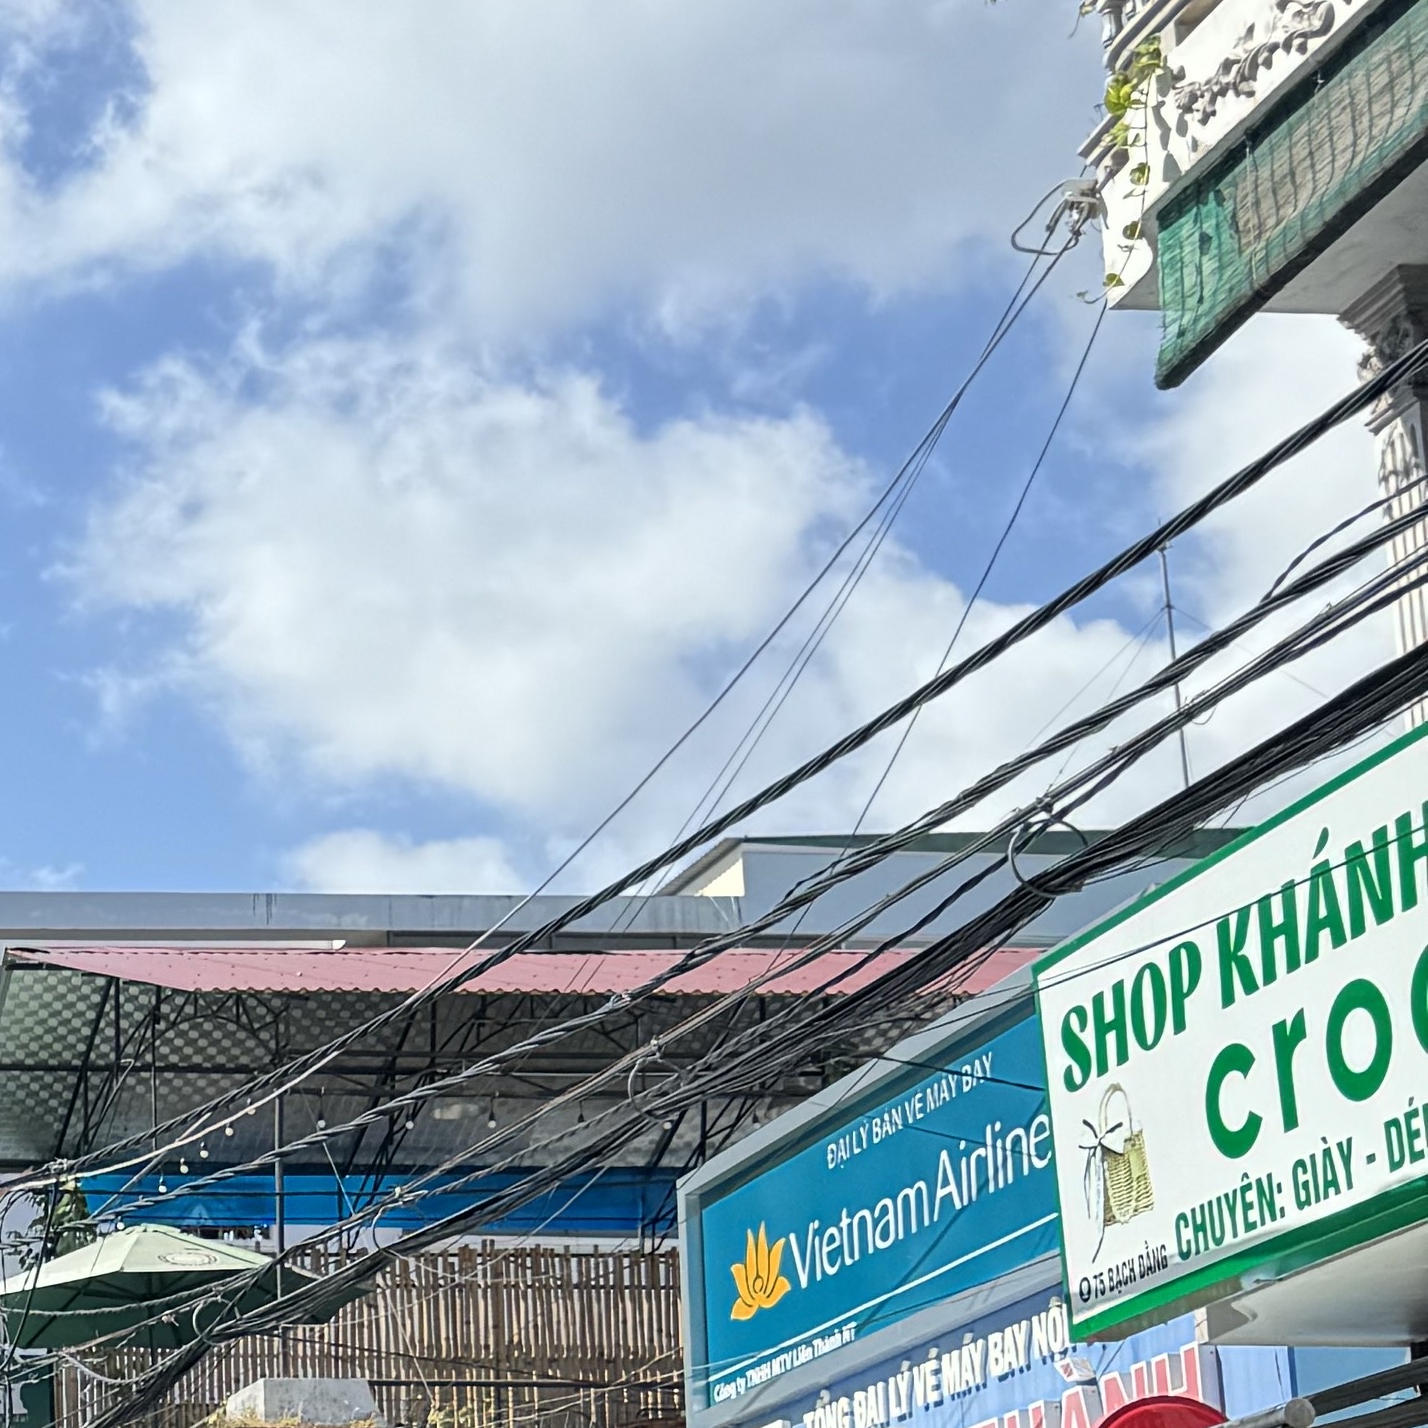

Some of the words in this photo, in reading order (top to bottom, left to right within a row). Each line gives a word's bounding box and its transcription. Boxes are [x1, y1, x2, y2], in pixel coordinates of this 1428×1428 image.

[1061, 939, 1202, 1093] SHOP
[827, 1141, 851, 1171] ĐẠI
[852, 1125, 870, 1156] LÝ
[872, 1109, 904, 1144] BÁN
[905, 1092, 925, 1126] VÉ
[926, 1076, 959, 1116] MÁY
[962, 1052, 993, 1093] BAY
[788, 1177, 930, 1290] Vietnam
[933, 1113, 1053, 1222] Airline
[1175, 1170, 1286, 1262] CHUYÊN:
[1292, 1136, 1355, 1214] GIÀY
[1384, 1096, 1428, 1174] DÉ
[1093, 1270, 1106, 1299] 75
[1107, 1256, 1137, 1298] BẠCH
[713, 1382, 737, 1403] Công
[746, 1361, 771, 1388] TNHH
[771, 1350, 792, 1377] MTV
[793, 1344, 813, 1367] Liên
[890, 1360, 913, 1420] LÝ
[913, 1347, 943, 1411] VÉ
[943, 1332, 988, 1399] MÁY
[988, 1319, 1031, 1381] BAY
